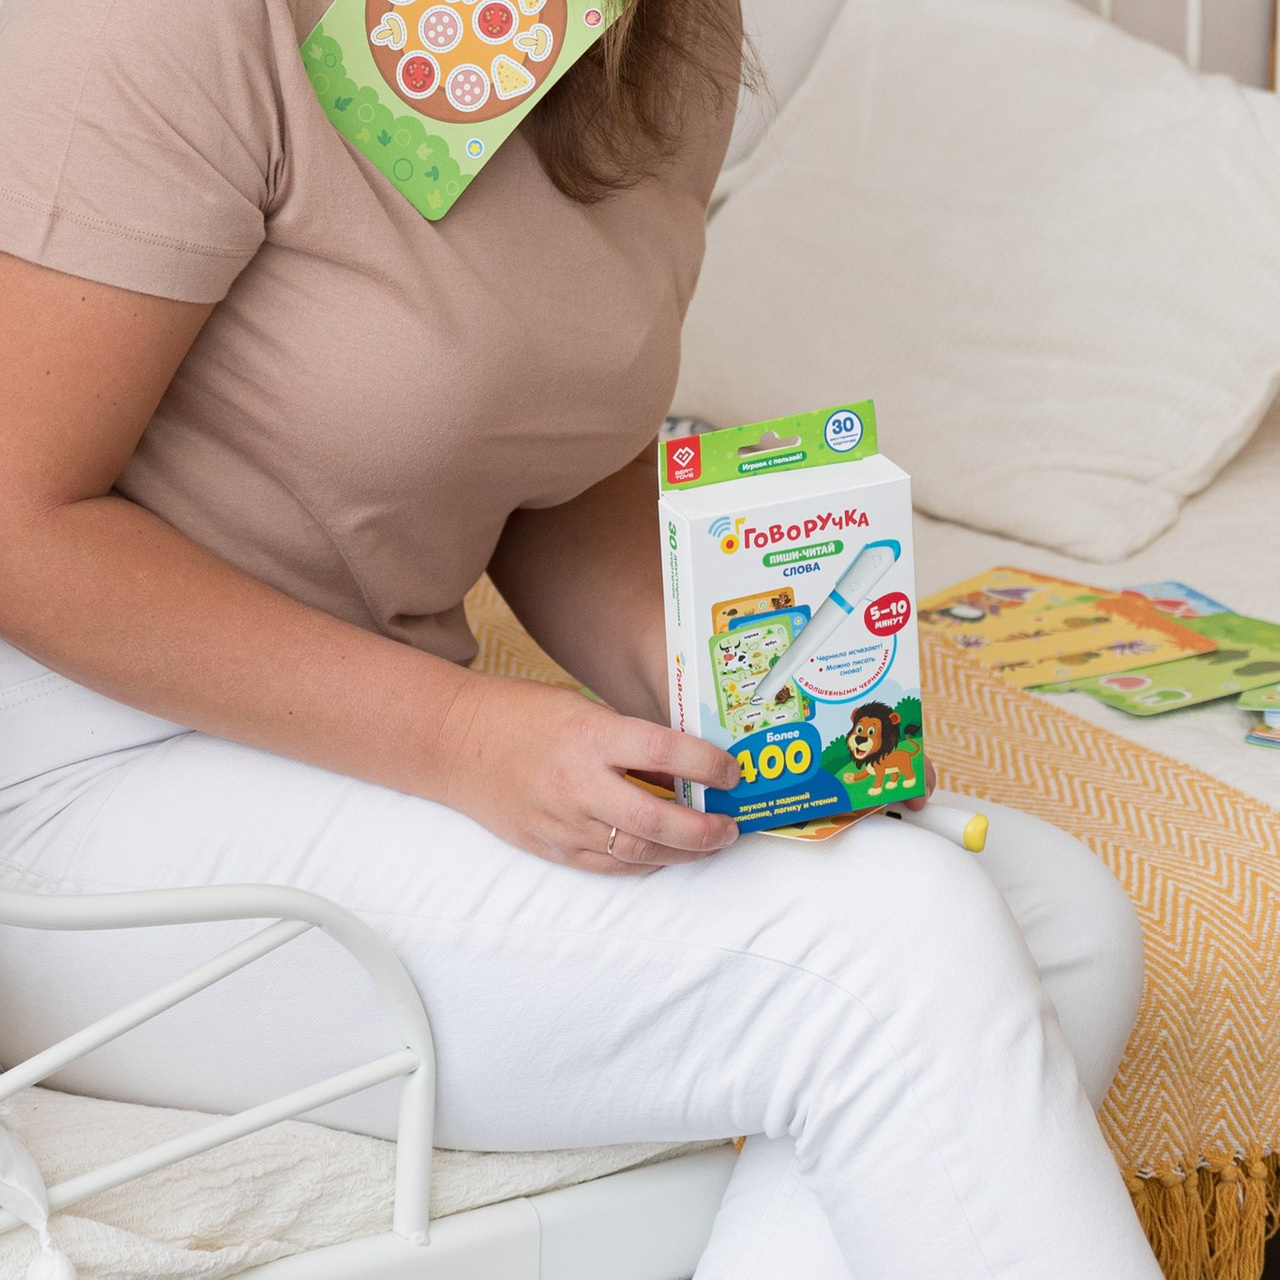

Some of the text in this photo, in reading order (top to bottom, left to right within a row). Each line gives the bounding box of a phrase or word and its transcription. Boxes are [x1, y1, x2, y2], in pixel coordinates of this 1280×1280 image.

[831, 416, 855, 435] 30
[742, 460, 767, 472] Играем
[668, 520, 678, 551] 30
[769, 542, 836, 565] ПИШИ-ЧИТАЙ
[782, 562, 821, 577] СЛОВА
[874, 616, 904, 629] МИНУТ
[816, 642, 883, 662] Чернила исчезают!
[804, 681, 858, 696] ВОЛШЕБНЫМИ
[859, 648, 889, 690] ЧЕРНИЛАМИ
[825, 657, 876, 671] Можно писать
[839, 666, 863, 676] снова!
[766, 730, 800, 743] Более
[737, 740, 812, 783] 400
[739, 801, 767, 813] звуков
[775, 792, 811, 806] заданий
[773, 804, 802, 815] логику
[810, 796, 838, 807] чтение
